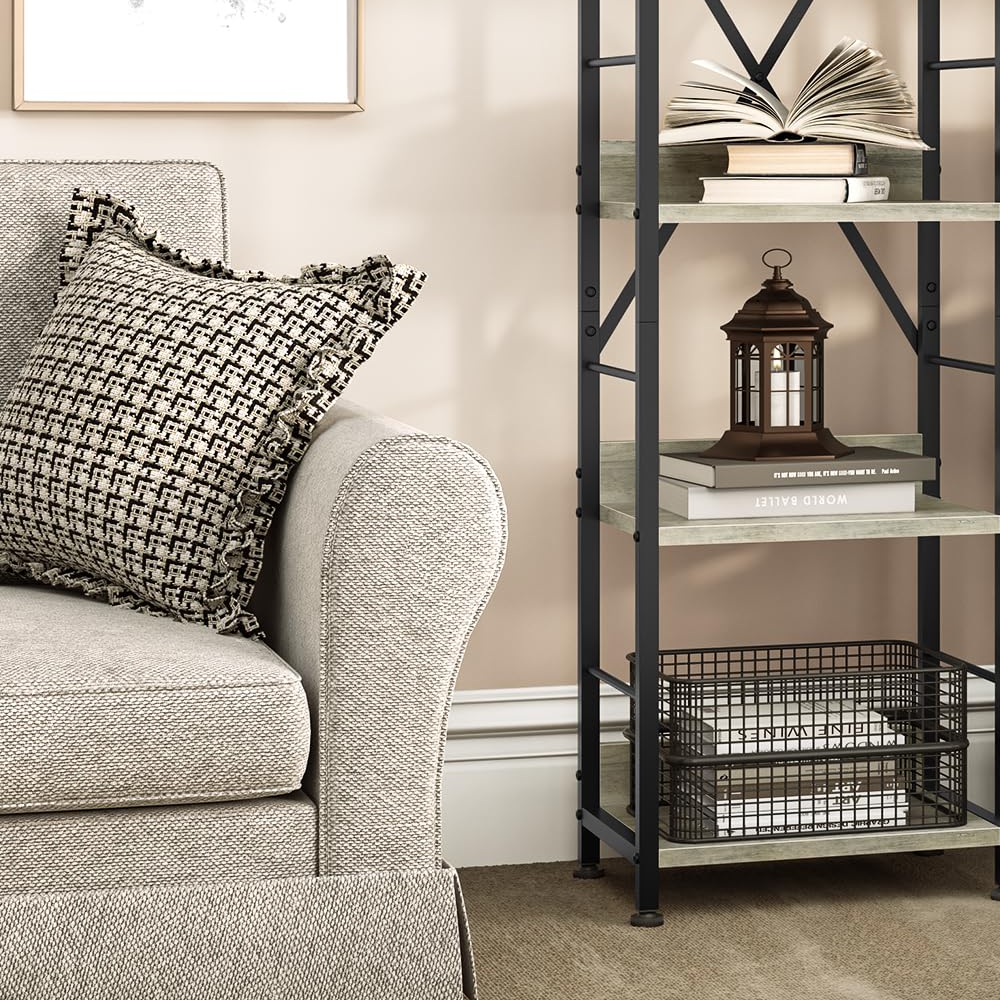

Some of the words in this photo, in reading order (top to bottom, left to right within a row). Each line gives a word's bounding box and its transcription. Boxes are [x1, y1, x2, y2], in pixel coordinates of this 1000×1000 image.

[755, 495, 797, 508] BALLET
[803, 494, 848, 506] WORLD
[738, 727, 808, 741] WINES
[818, 724, 864, 736] FINE
